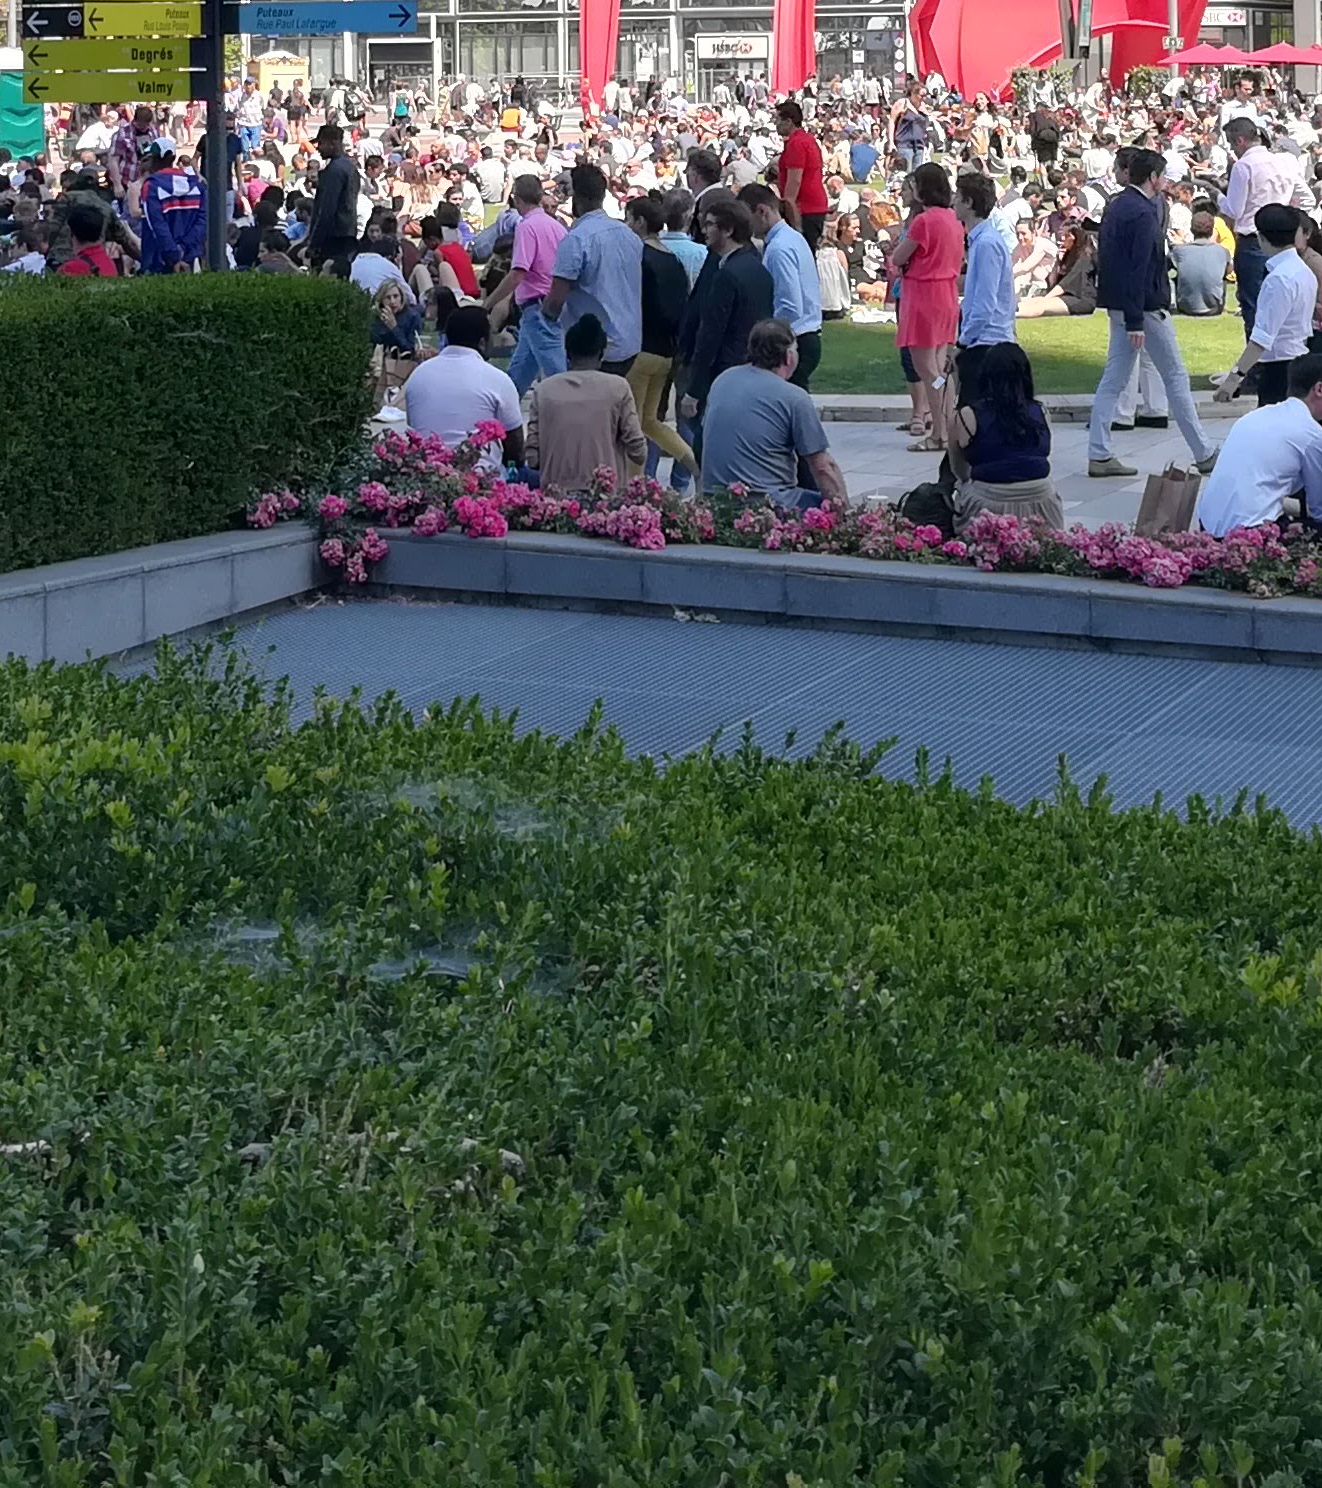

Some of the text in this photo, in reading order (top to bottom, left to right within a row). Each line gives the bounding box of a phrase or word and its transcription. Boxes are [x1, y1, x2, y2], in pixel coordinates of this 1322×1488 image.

[257, 7, 294, 18] Puteaux
[257, 18, 336, 32] Rue Paul Lafargue
[131, 47, 173, 63] Degrés
[138, 81, 173, 96] Valmy
